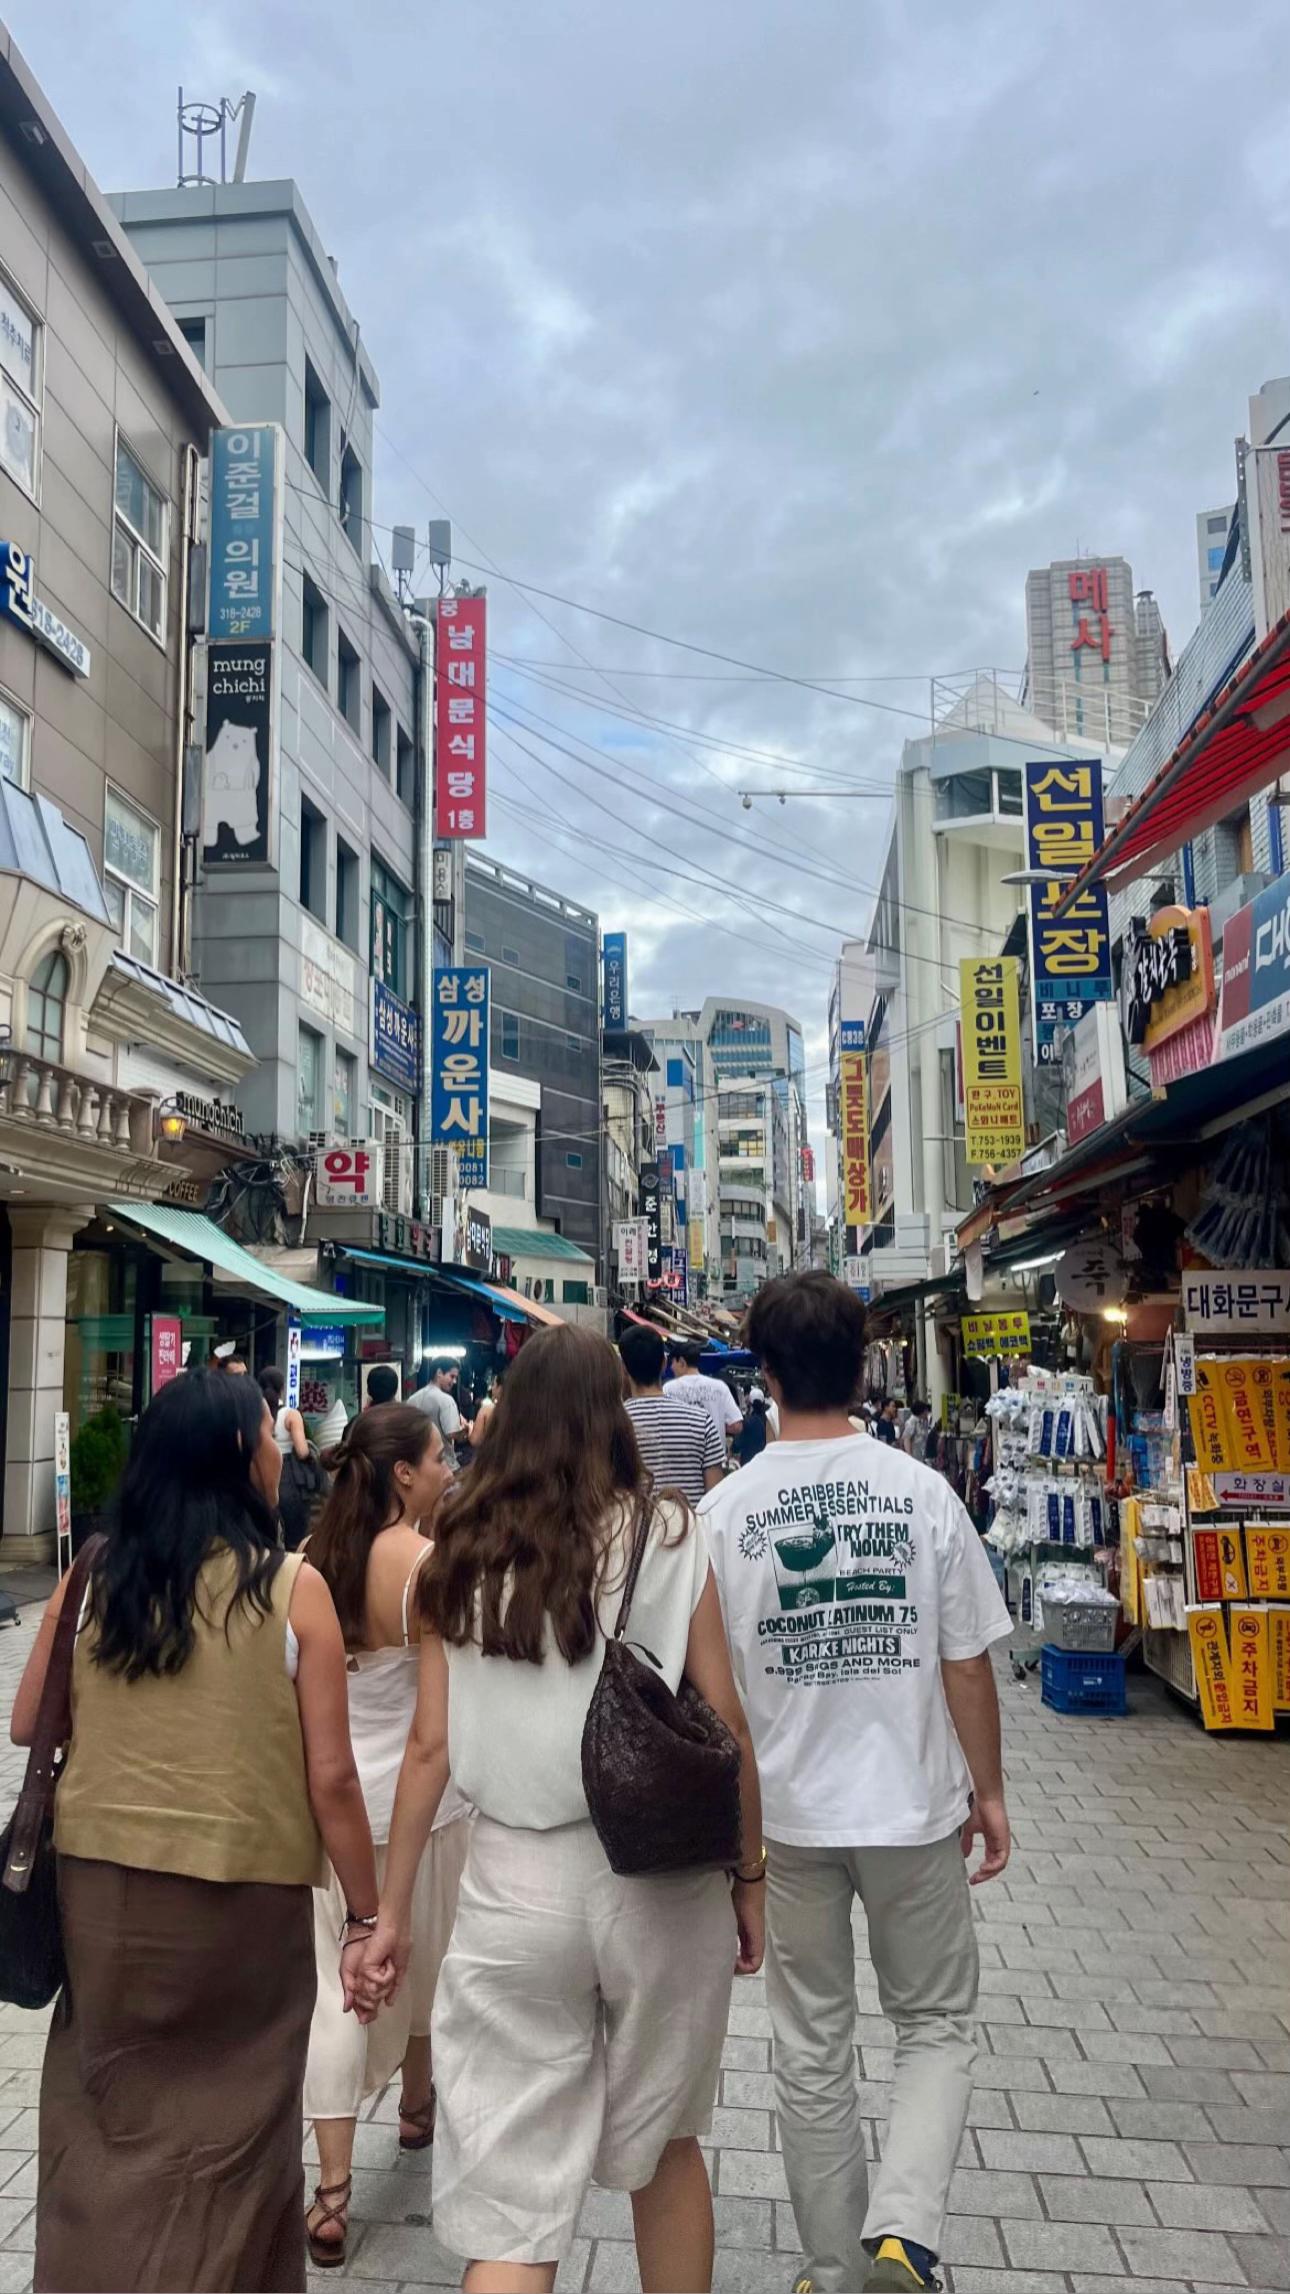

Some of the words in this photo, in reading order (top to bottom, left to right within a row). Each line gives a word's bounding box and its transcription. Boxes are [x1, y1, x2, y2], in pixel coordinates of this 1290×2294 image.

[224, 431, 262, 520] 이준걸
[224, 538, 260, 600] 의원
[220, 607, 262, 621] 318-2428
[1069, 567, 1114, 663] 메사
[230, 621, 251, 634] 2F
[213, 658, 266, 676] mung
[212, 677, 266, 694] chichi
[447, 625, 475, 798] 남대문식당
[448, 810, 475, 830] 1층
[437, 974, 486, 1004] 삼성
[609, 961, 621, 1020] 우리은행
[973, 963, 1008, 1080] 선일이벤트
[1041, 1001, 1084, 1020] 포장
[440, 1008, 485, 1137] 까운사
[997, 1088, 1015, 1099] TOY
[1002, 1102, 1019, 1111] Card
[845, 1058, 868, 1213] 그릇도매상가
[323, 1151, 371, 1194] 약
[168, 1181, 199, 1201] COFFEE
[1187, 1284, 1290, 1319] 대화문구
[1202, 1394, 1218, 1429] CCTV
[1233, 1390, 1262, 1459] 금연구역
[778, 1480, 869, 1506] CARIBBEAN
[1234, 1478, 1285, 1493] 화장실
[746, 1503, 816, 1531] SUMMER
[818, 1497, 914, 1517] ESSENTIALS
[866, 1522, 909, 1542] THEM
[839, 1568, 871, 1577] BEACH
[872, 1567, 905, 1576] PARTY
[846, 1581, 876, 1592] Hosted
[757, 1610, 825, 1636] COCONUT
[899, 1604, 918, 1624] 75
[843, 1626, 873, 1635] GUEST
[875, 1626, 894, 1634] LIST
[841, 1636, 896, 1655] NIGHTS
[842, 1657, 873, 1668] AND
[877, 1658, 921, 1668] MORE
[863, 1667, 880, 1675] del
[883, 1667, 902, 1675] Sol
[1241, 1642, 1258, 1716] 주차금지
